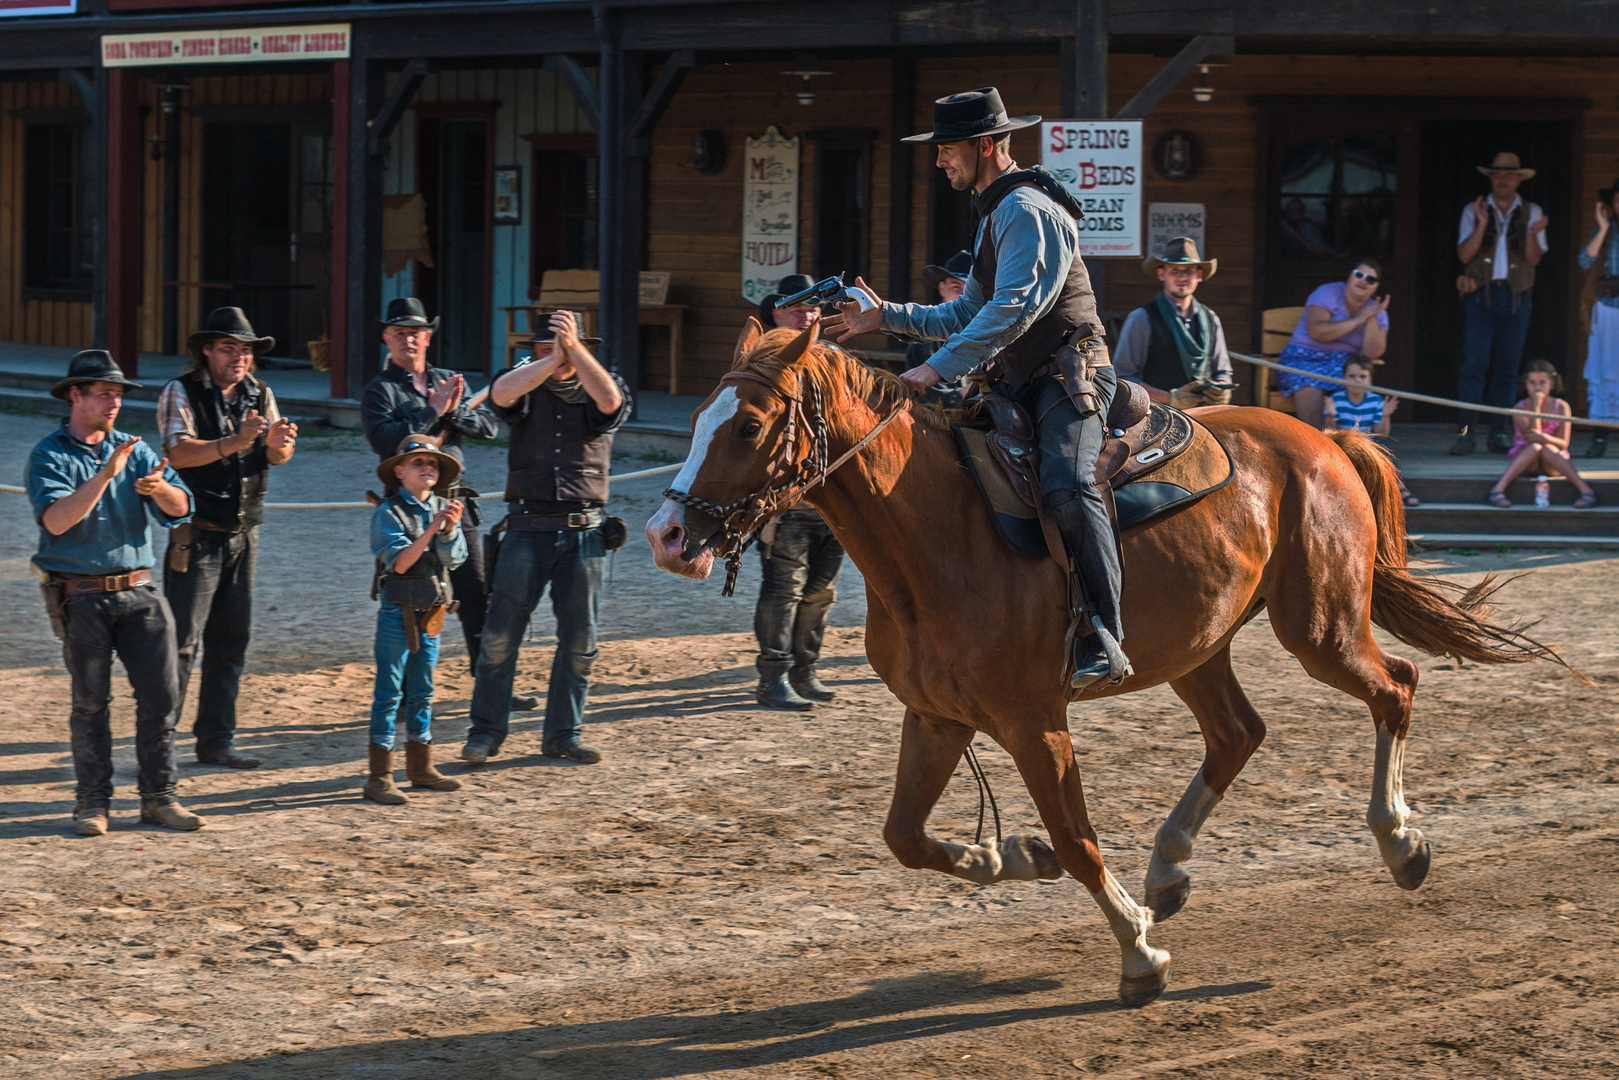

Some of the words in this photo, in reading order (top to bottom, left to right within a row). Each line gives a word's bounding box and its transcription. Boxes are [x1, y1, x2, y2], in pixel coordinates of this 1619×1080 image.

[1050, 125, 1130, 153] SPRING
[1078, 161, 1136, 190] BEDS
[1082, 198, 1125, 213] EAN
[1077, 217, 1125, 231] OOMS
[745, 241, 794, 267] HOTEL
